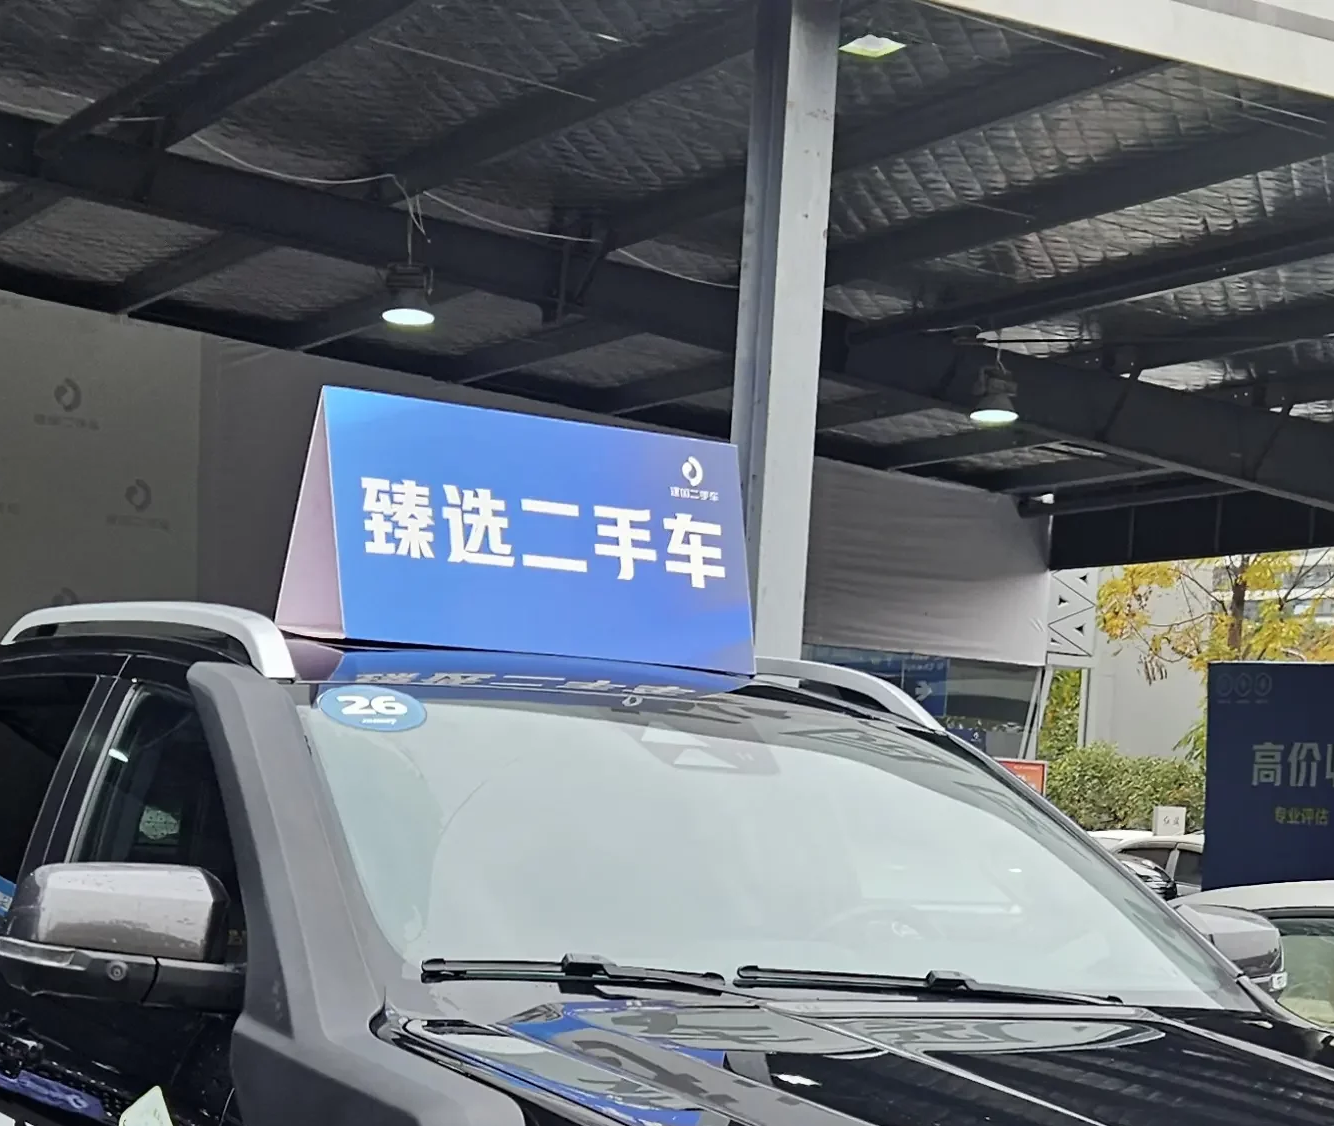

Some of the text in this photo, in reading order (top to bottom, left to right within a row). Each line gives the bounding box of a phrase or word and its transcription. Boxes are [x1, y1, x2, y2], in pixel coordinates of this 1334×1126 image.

[361, 476, 725, 588] 臻选二手车
[336, 695, 408, 715] 26
[1274, 806, 1328, 826] 专业评估
